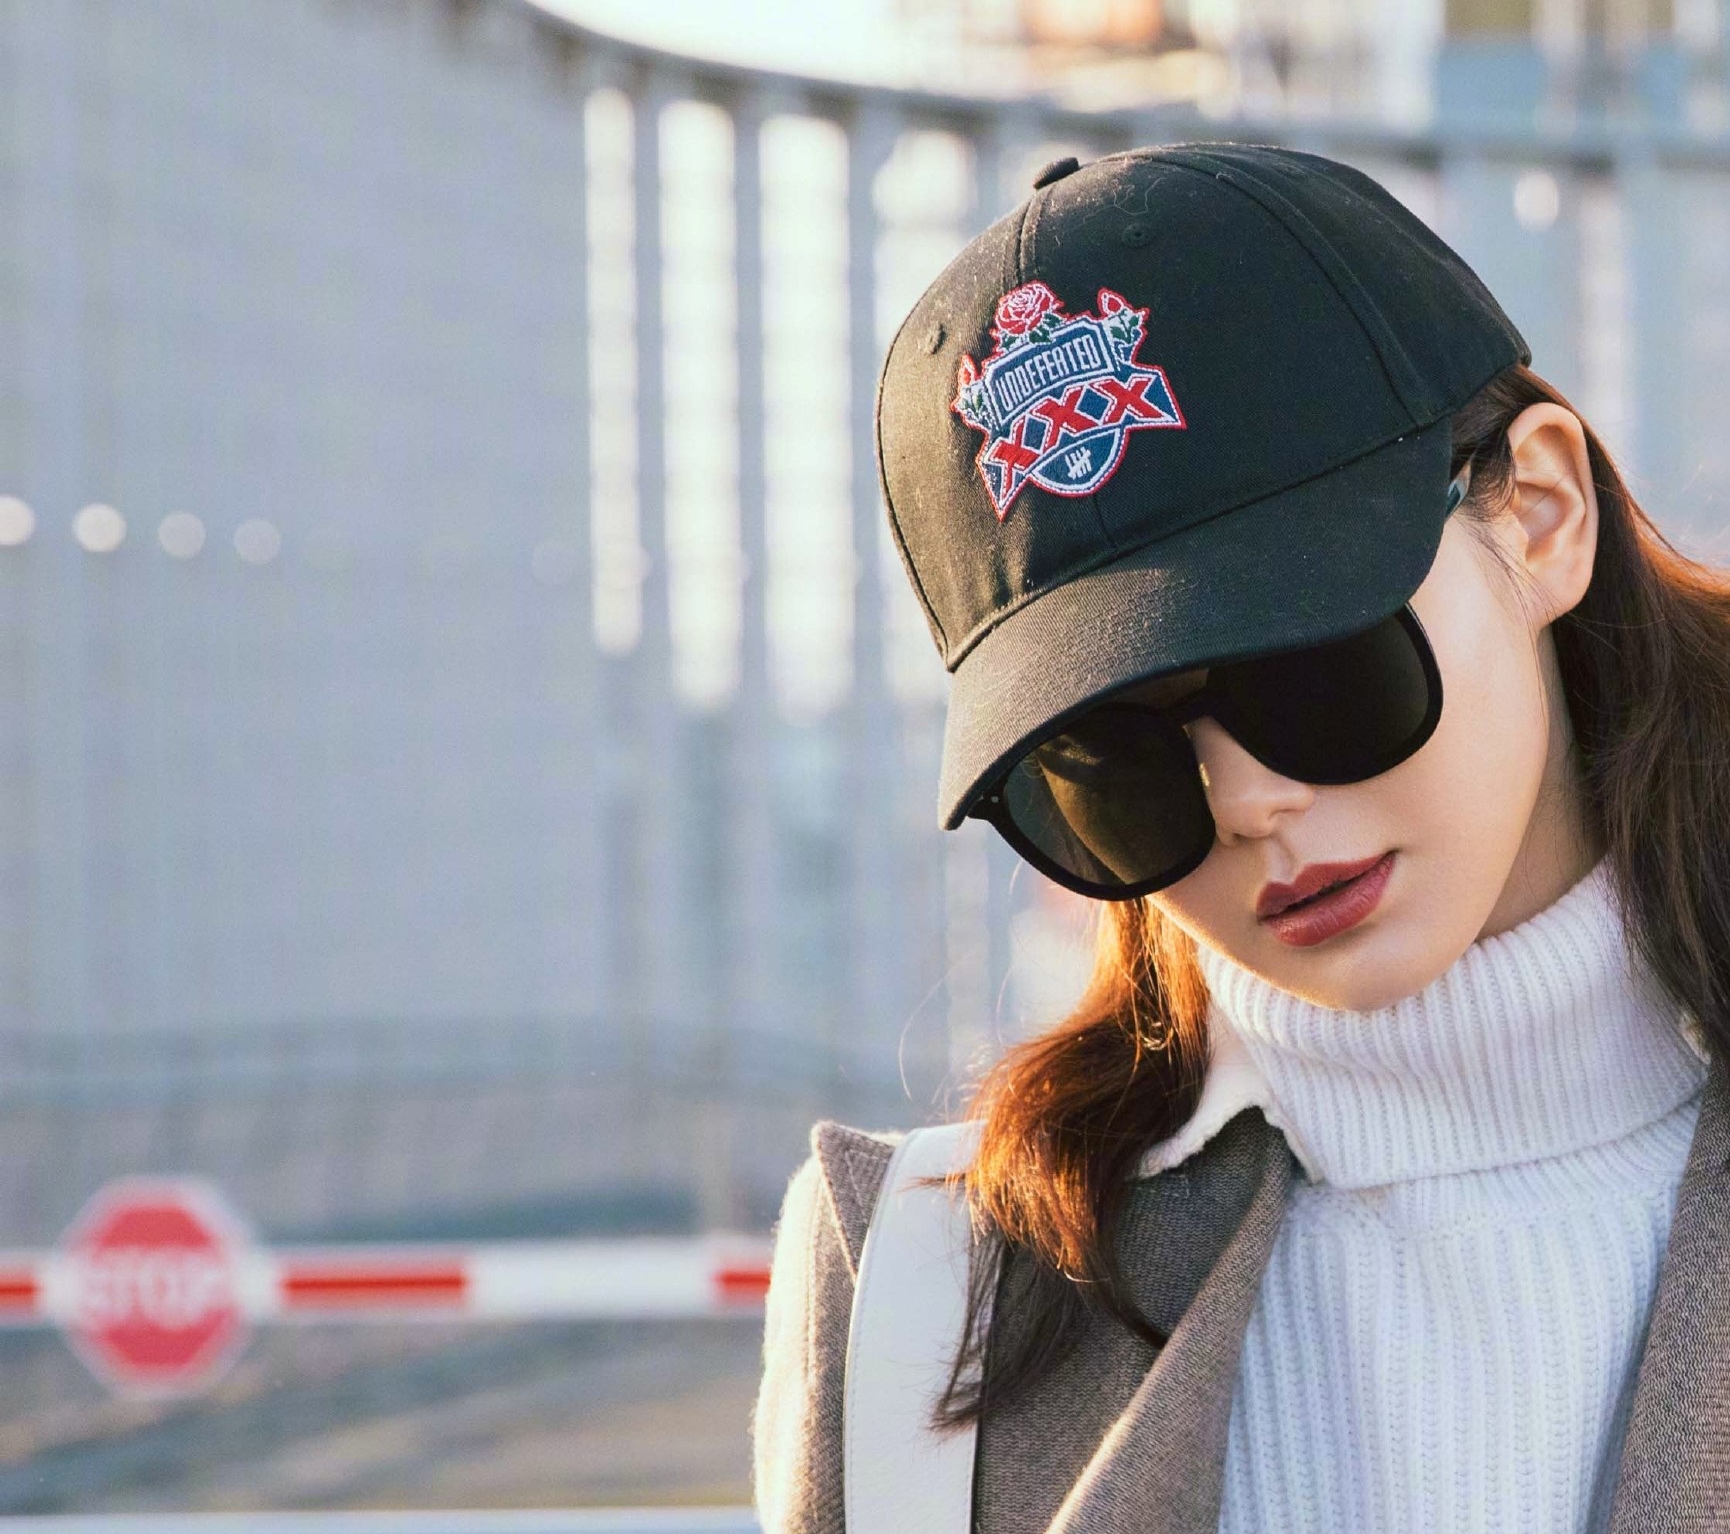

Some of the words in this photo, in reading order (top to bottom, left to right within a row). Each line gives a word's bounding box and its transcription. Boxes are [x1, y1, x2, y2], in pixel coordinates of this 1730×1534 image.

[996, 333, 1102, 412] UNDEFEATED
[984, 375, 1173, 500] XXX
[80, 1249, 225, 1325] STOP
